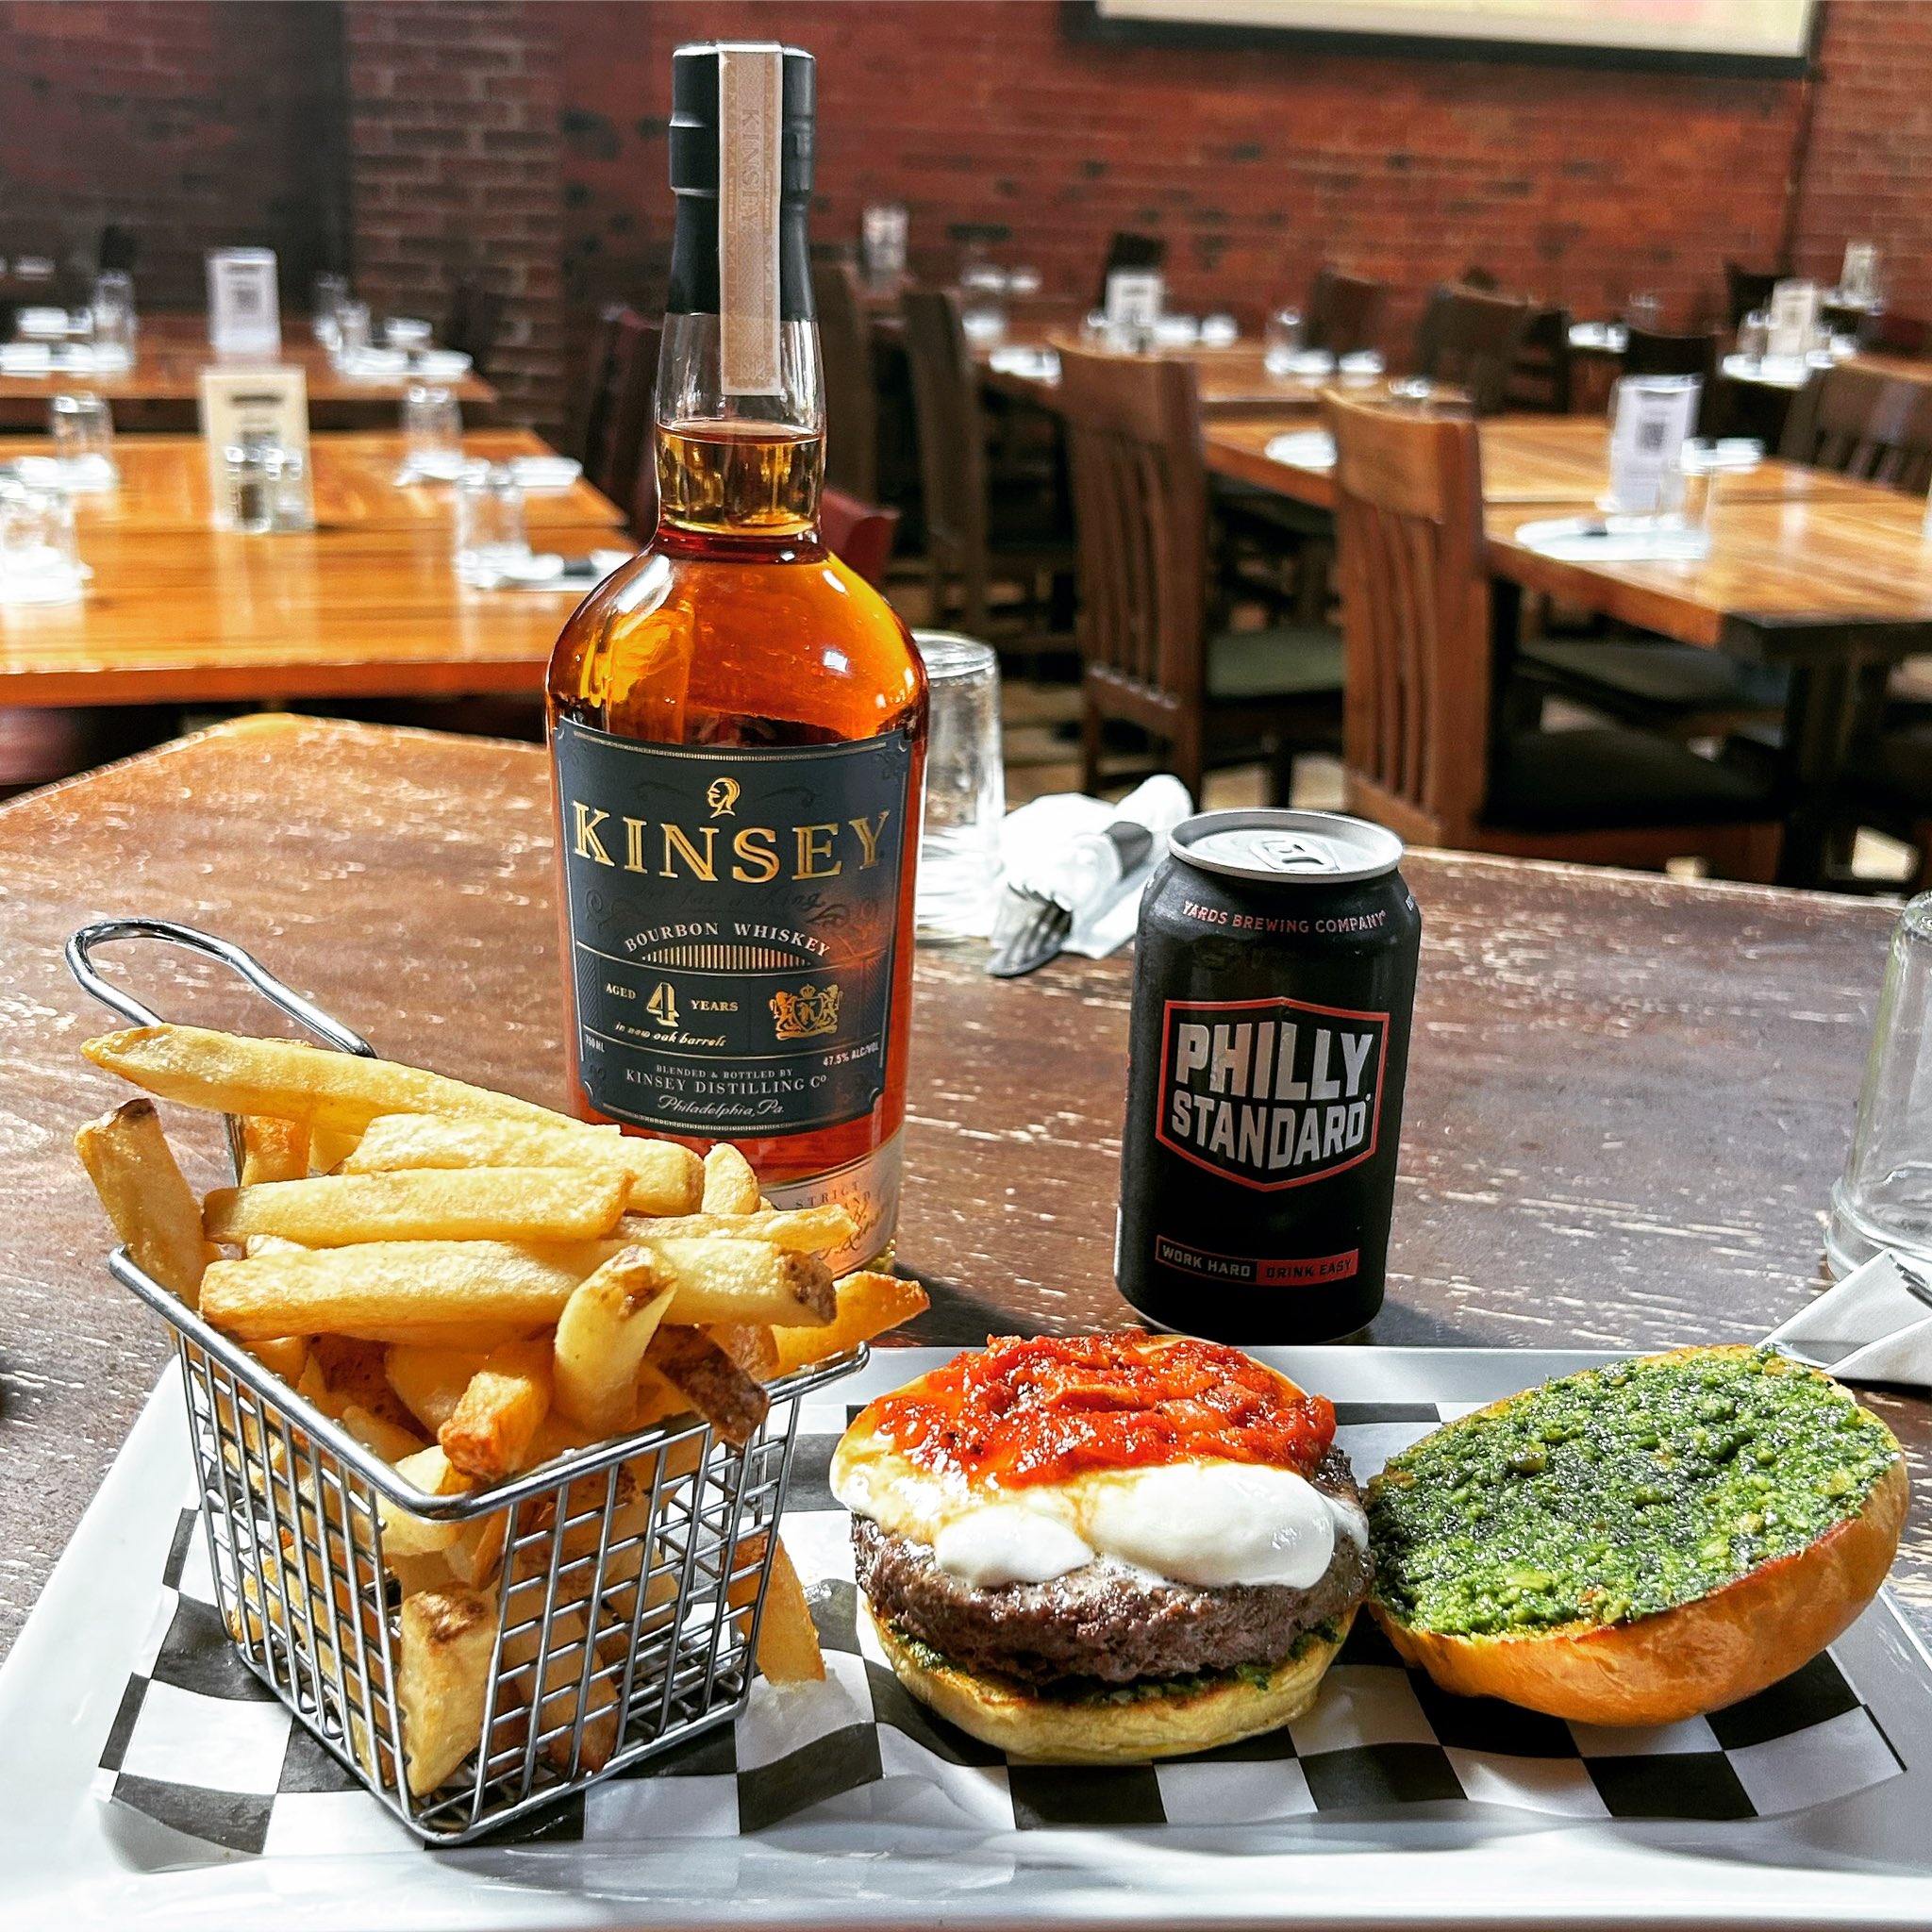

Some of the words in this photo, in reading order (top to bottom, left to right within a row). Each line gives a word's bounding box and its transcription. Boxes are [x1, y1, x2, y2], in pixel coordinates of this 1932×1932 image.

[741, 108, 761, 229] KINSEY
[573, 800, 891, 884] KINSEY
[1182, 900, 1227, 924] YARDS
[1232, 914, 1309, 933] BREWING
[625, 923, 719, 953] BOURBON
[734, 923, 831, 957] WHISKEY
[606, 983, 637, 1000] AGED
[646, 982, 680, 1027] 4
[691, 1000, 739, 1011] YEARS
[615, 1022, 625, 1032] in
[627, 1026, 651, 1039] new
[653, 1031, 678, 1043] oak
[679, 1032, 726, 1047] barrels
[657, 1064, 706, 1078] BLENDED
[724, 1071, 774, 1079] BOTTLED
[780, 1069, 793, 1077] BY
[823, 1052, 849, 1067] 47.5%
[1175, 1021, 1374, 1101] PHILLY
[626, 1069, 686, 1091] KINSEY
[694, 1078, 805, 1094] DISTILLING
[657, 1094, 756, 1119] Philadelphia,
[756, 1099, 785, 1115] Pa.
[1172, 1090, 1368, 1170] STANDARD
[1162, 1243, 1203, 1269] WORK
[1208, 1259, 1252, 1277] HARD
[1265, 1266, 1314, 1278] DRINK
[1319, 1257, 1352, 1274] EASY
